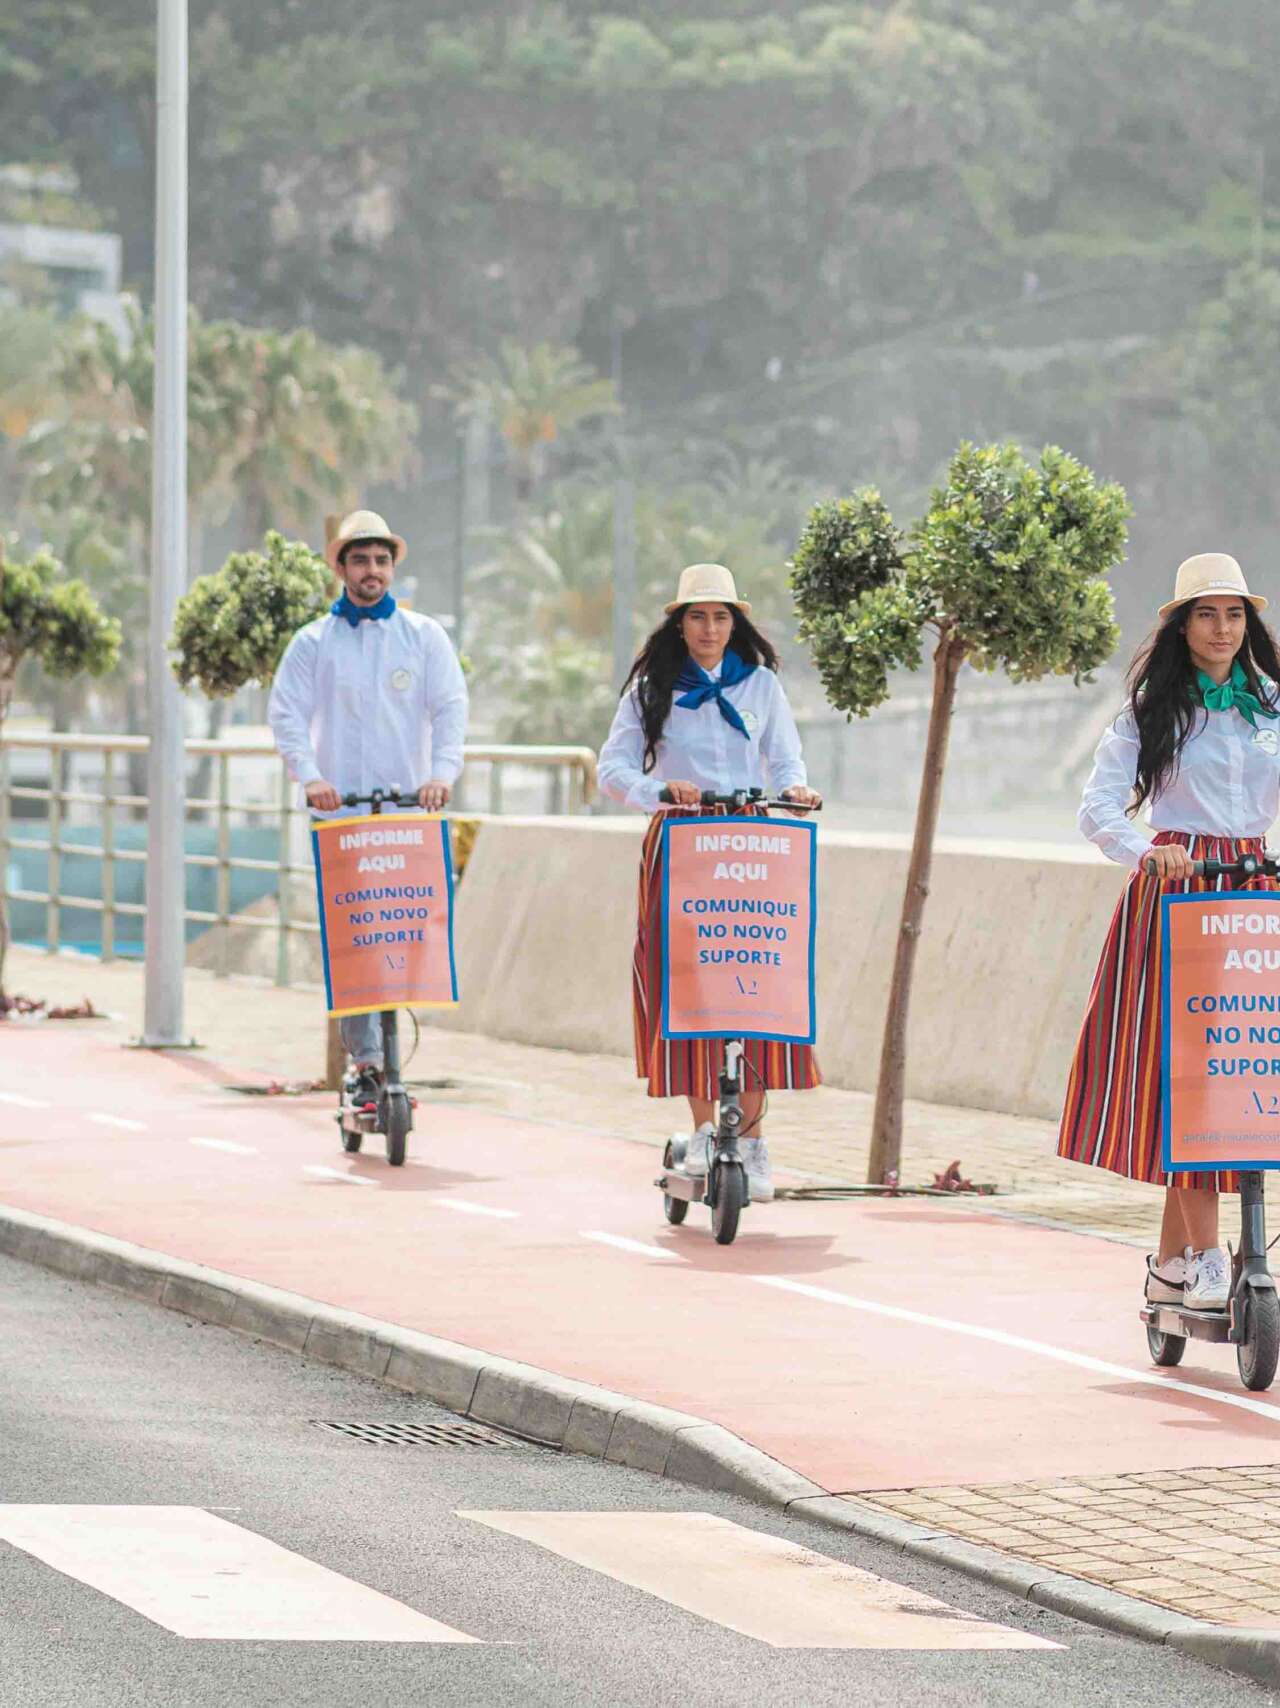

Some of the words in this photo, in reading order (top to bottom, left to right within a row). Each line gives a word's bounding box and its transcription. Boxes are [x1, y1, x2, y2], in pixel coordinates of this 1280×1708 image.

[339, 829, 424, 850] INFORME
[695, 835, 791, 855] INFORME
[358, 854, 405, 873] AQUI
[713, 862, 769, 883] AQUI
[335, 886, 435, 905] COMUNIQUE
[350, 911, 374, 925] NO
[380, 907, 428, 922] NOVO
[682, 899, 798, 918] COMUNIQUE
[352, 929, 424, 947] SUPORTE
[698, 924, 727, 939] NO
[733, 924, 787, 941] NOVO
[699, 949, 781, 966] SUPORTE
[1205, 1026, 1241, 1044] NO
